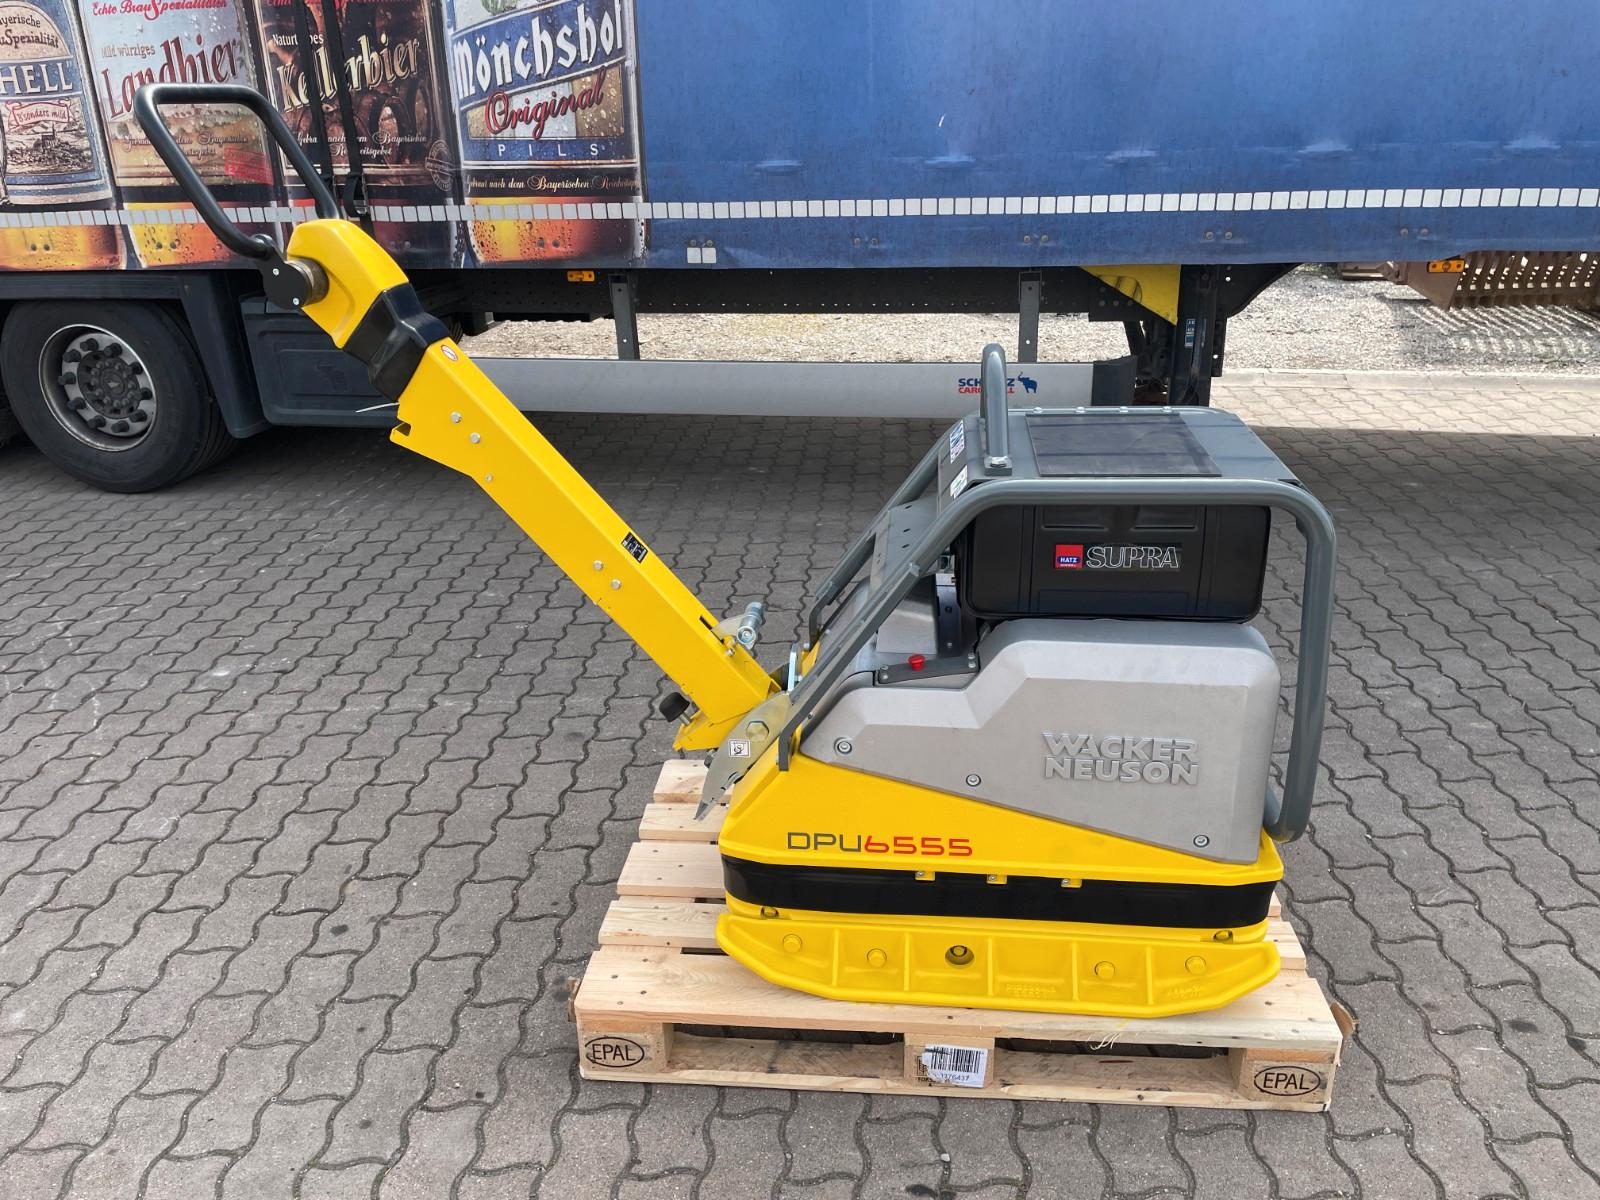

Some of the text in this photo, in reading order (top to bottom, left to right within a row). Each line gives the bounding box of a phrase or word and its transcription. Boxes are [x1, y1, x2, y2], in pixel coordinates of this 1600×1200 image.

[92, 2, 117, 16] Echte
[118, 43, 156, 59] würziges
[453, 0, 624, 100] Mönchshof
[0, 62, 73, 95] HELL
[101, 33, 239, 119] Landbier
[485, 65, 607, 140] Original
[51, 110, 67, 120] mild
[508, 177, 526, 189] dem
[527, 175, 590, 193] Bayerischen
[1086, 546, 1179, 569] SUPRA
[1042, 731, 1200, 762] WACKER
[1045, 756, 1200, 786] NEUSON
[592, 1043, 637, 1061] EPAL
[1263, 1072, 1310, 1090] EPAL
